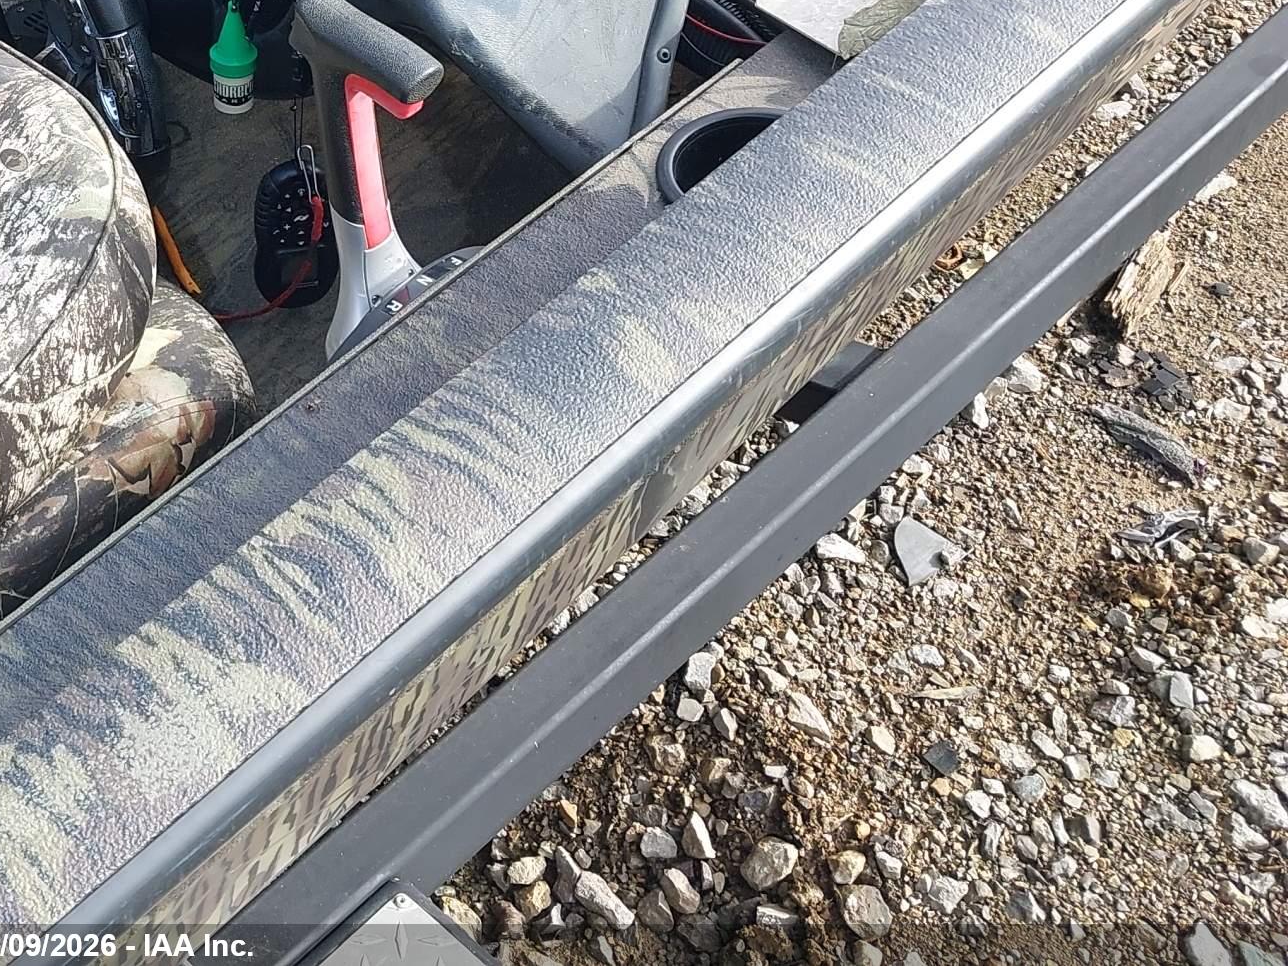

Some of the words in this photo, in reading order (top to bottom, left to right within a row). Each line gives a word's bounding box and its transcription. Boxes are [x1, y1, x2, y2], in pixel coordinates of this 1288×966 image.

[451, 256, 463, 266] F
[416, 274, 433, 286] N
[387, 300, 403, 312] R
